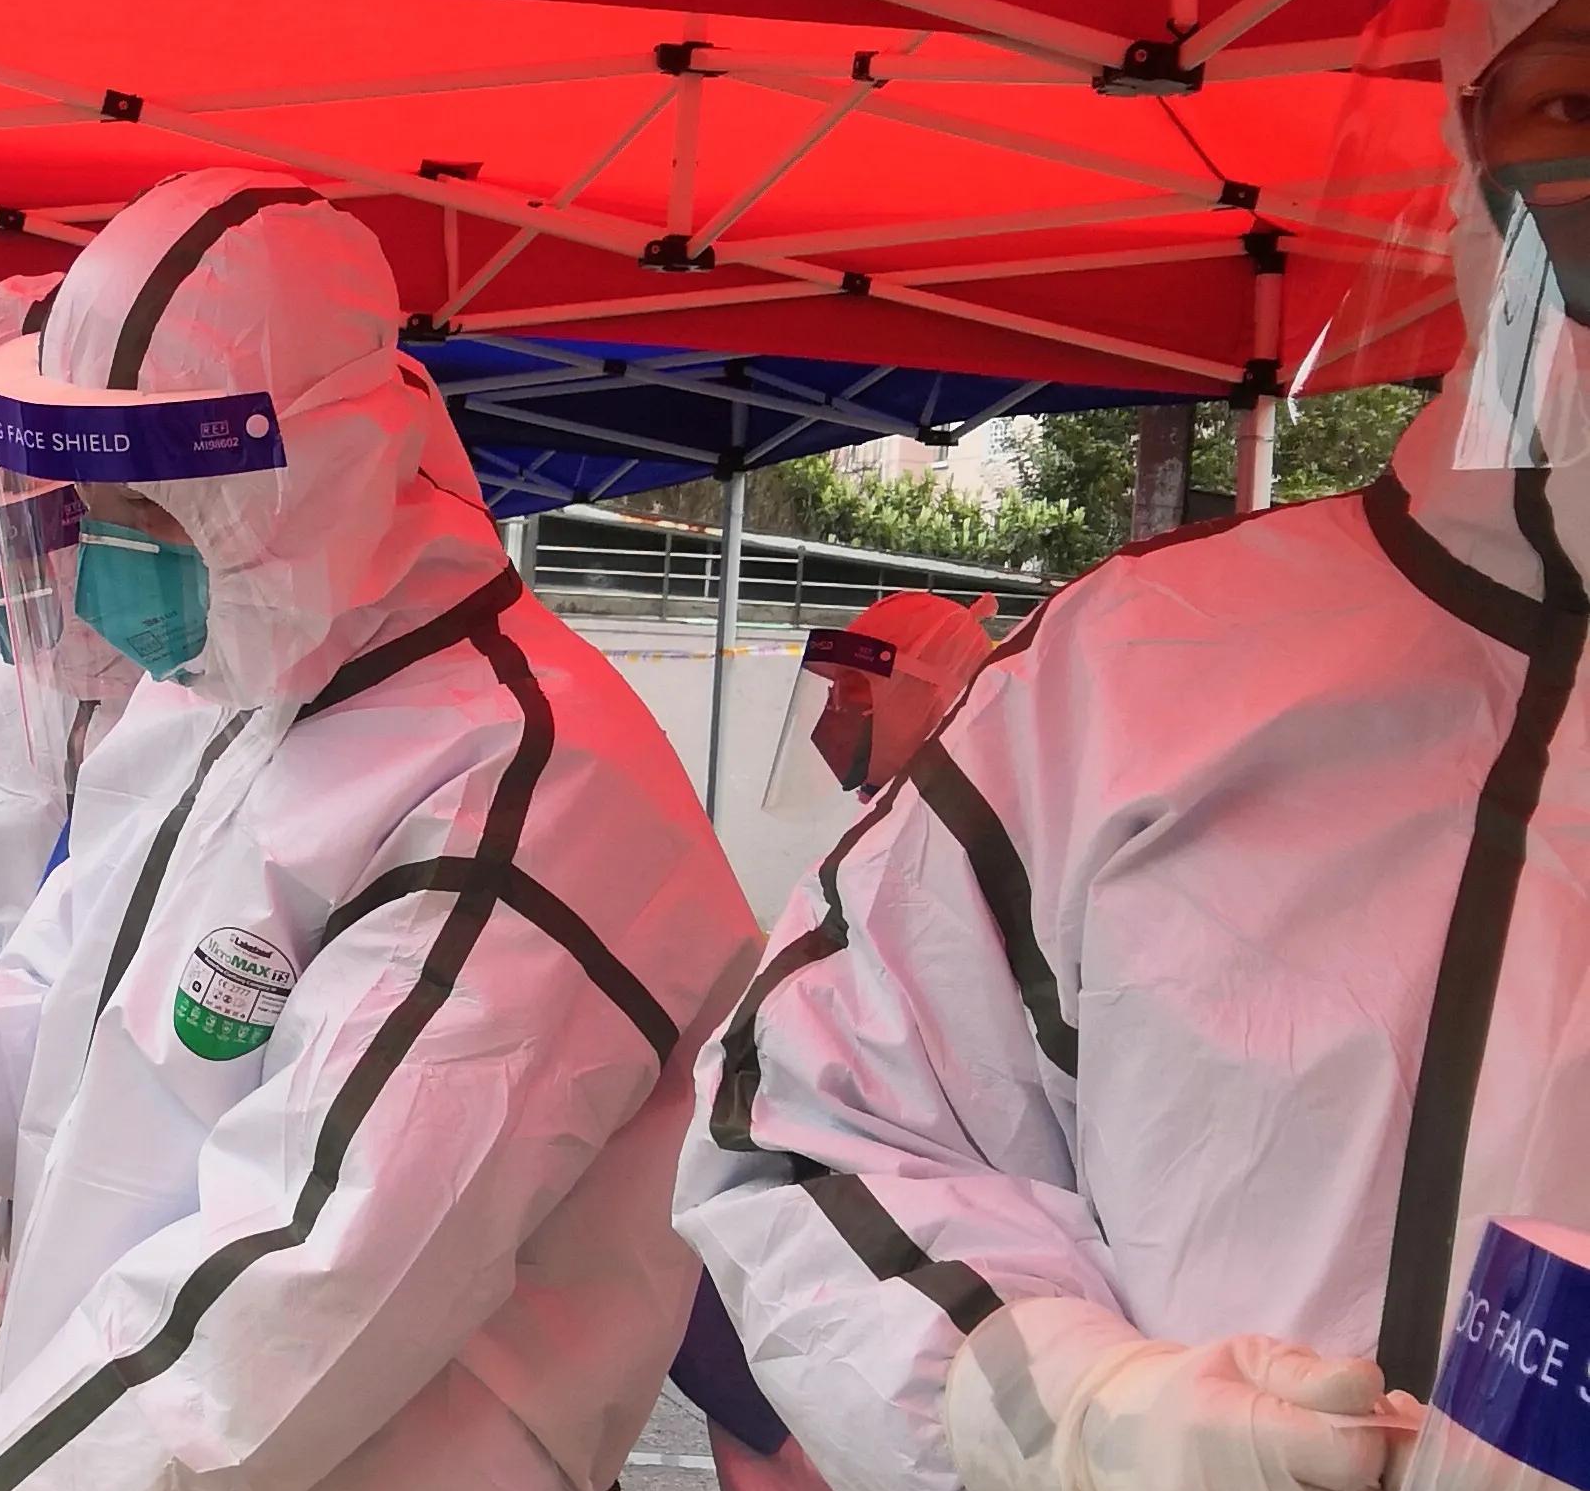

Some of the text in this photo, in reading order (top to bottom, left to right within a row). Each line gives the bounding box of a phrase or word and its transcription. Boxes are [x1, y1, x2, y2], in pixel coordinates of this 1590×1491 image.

[7, 424, 46, 450] FACE
[52, 432, 130, 453] SHIELD
[1489, 1310, 1570, 1386] FACE
